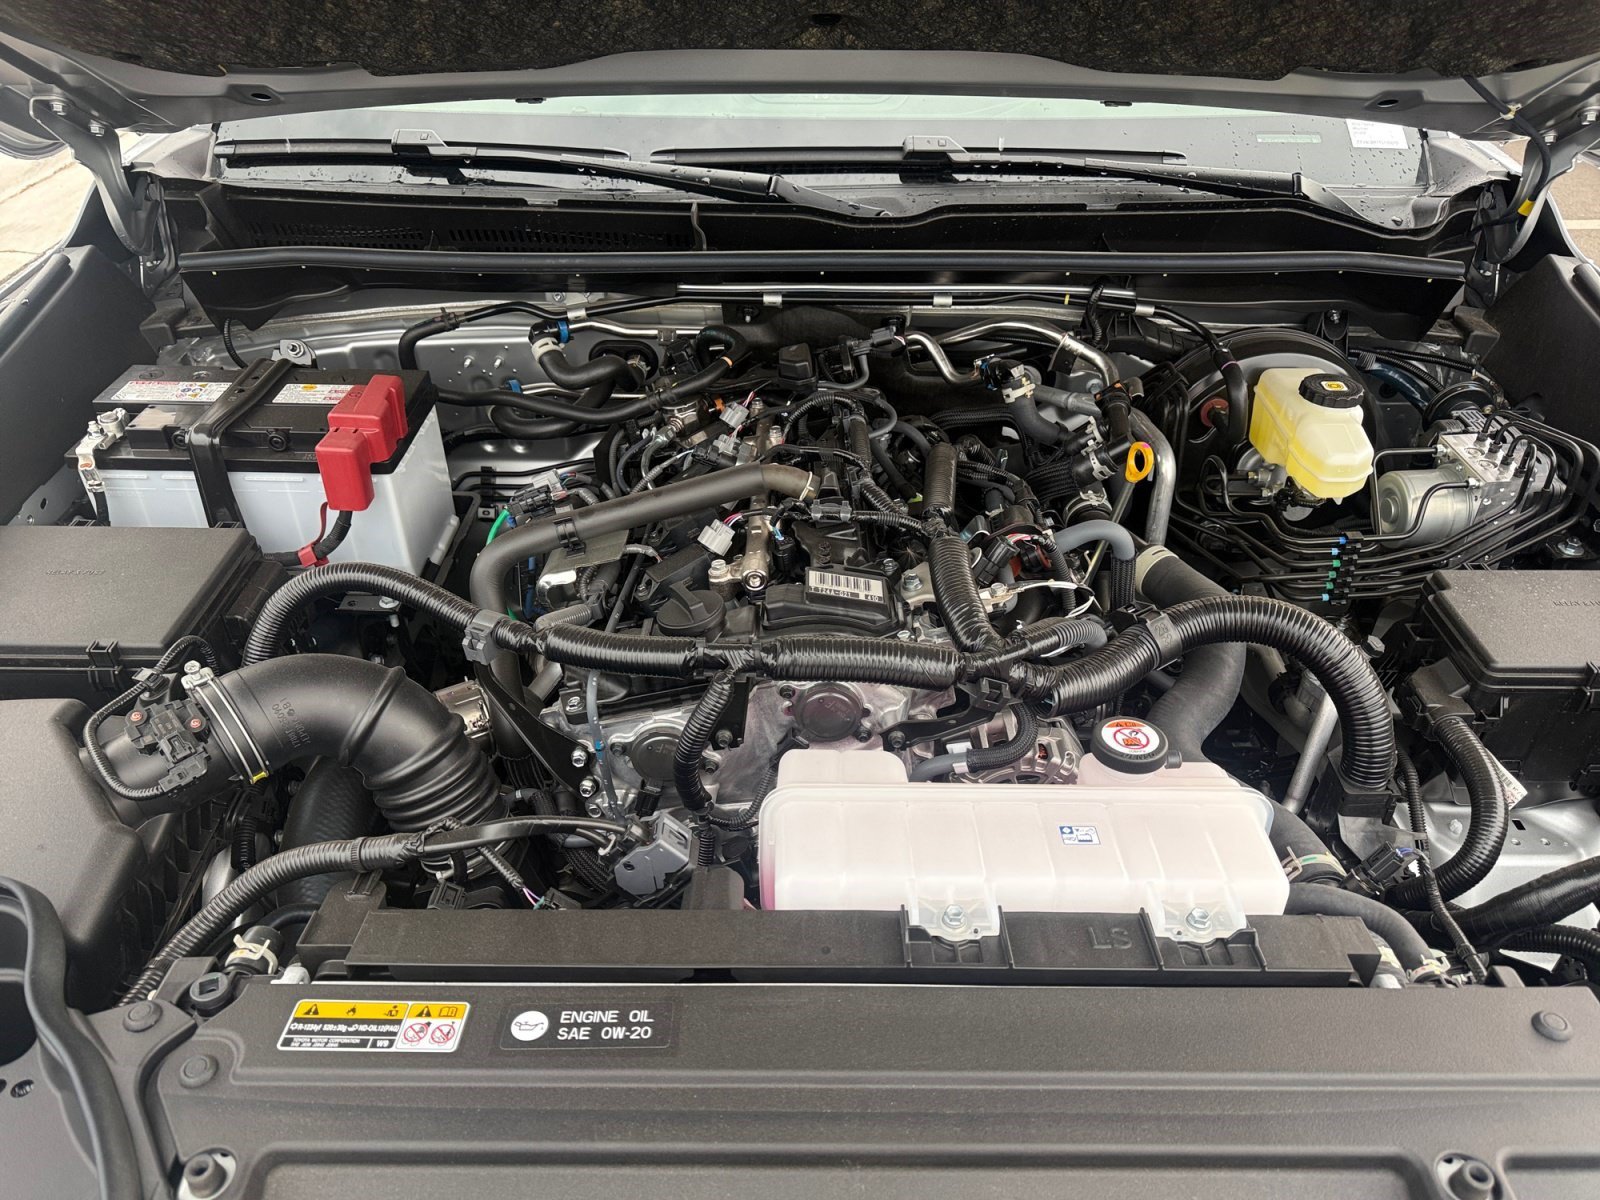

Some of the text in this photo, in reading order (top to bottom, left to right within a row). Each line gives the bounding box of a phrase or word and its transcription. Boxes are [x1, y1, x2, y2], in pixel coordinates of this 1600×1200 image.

[559, 1009, 654, 1023] ENGINE OIL
[557, 1026, 652, 1040] SAE 0W-20
